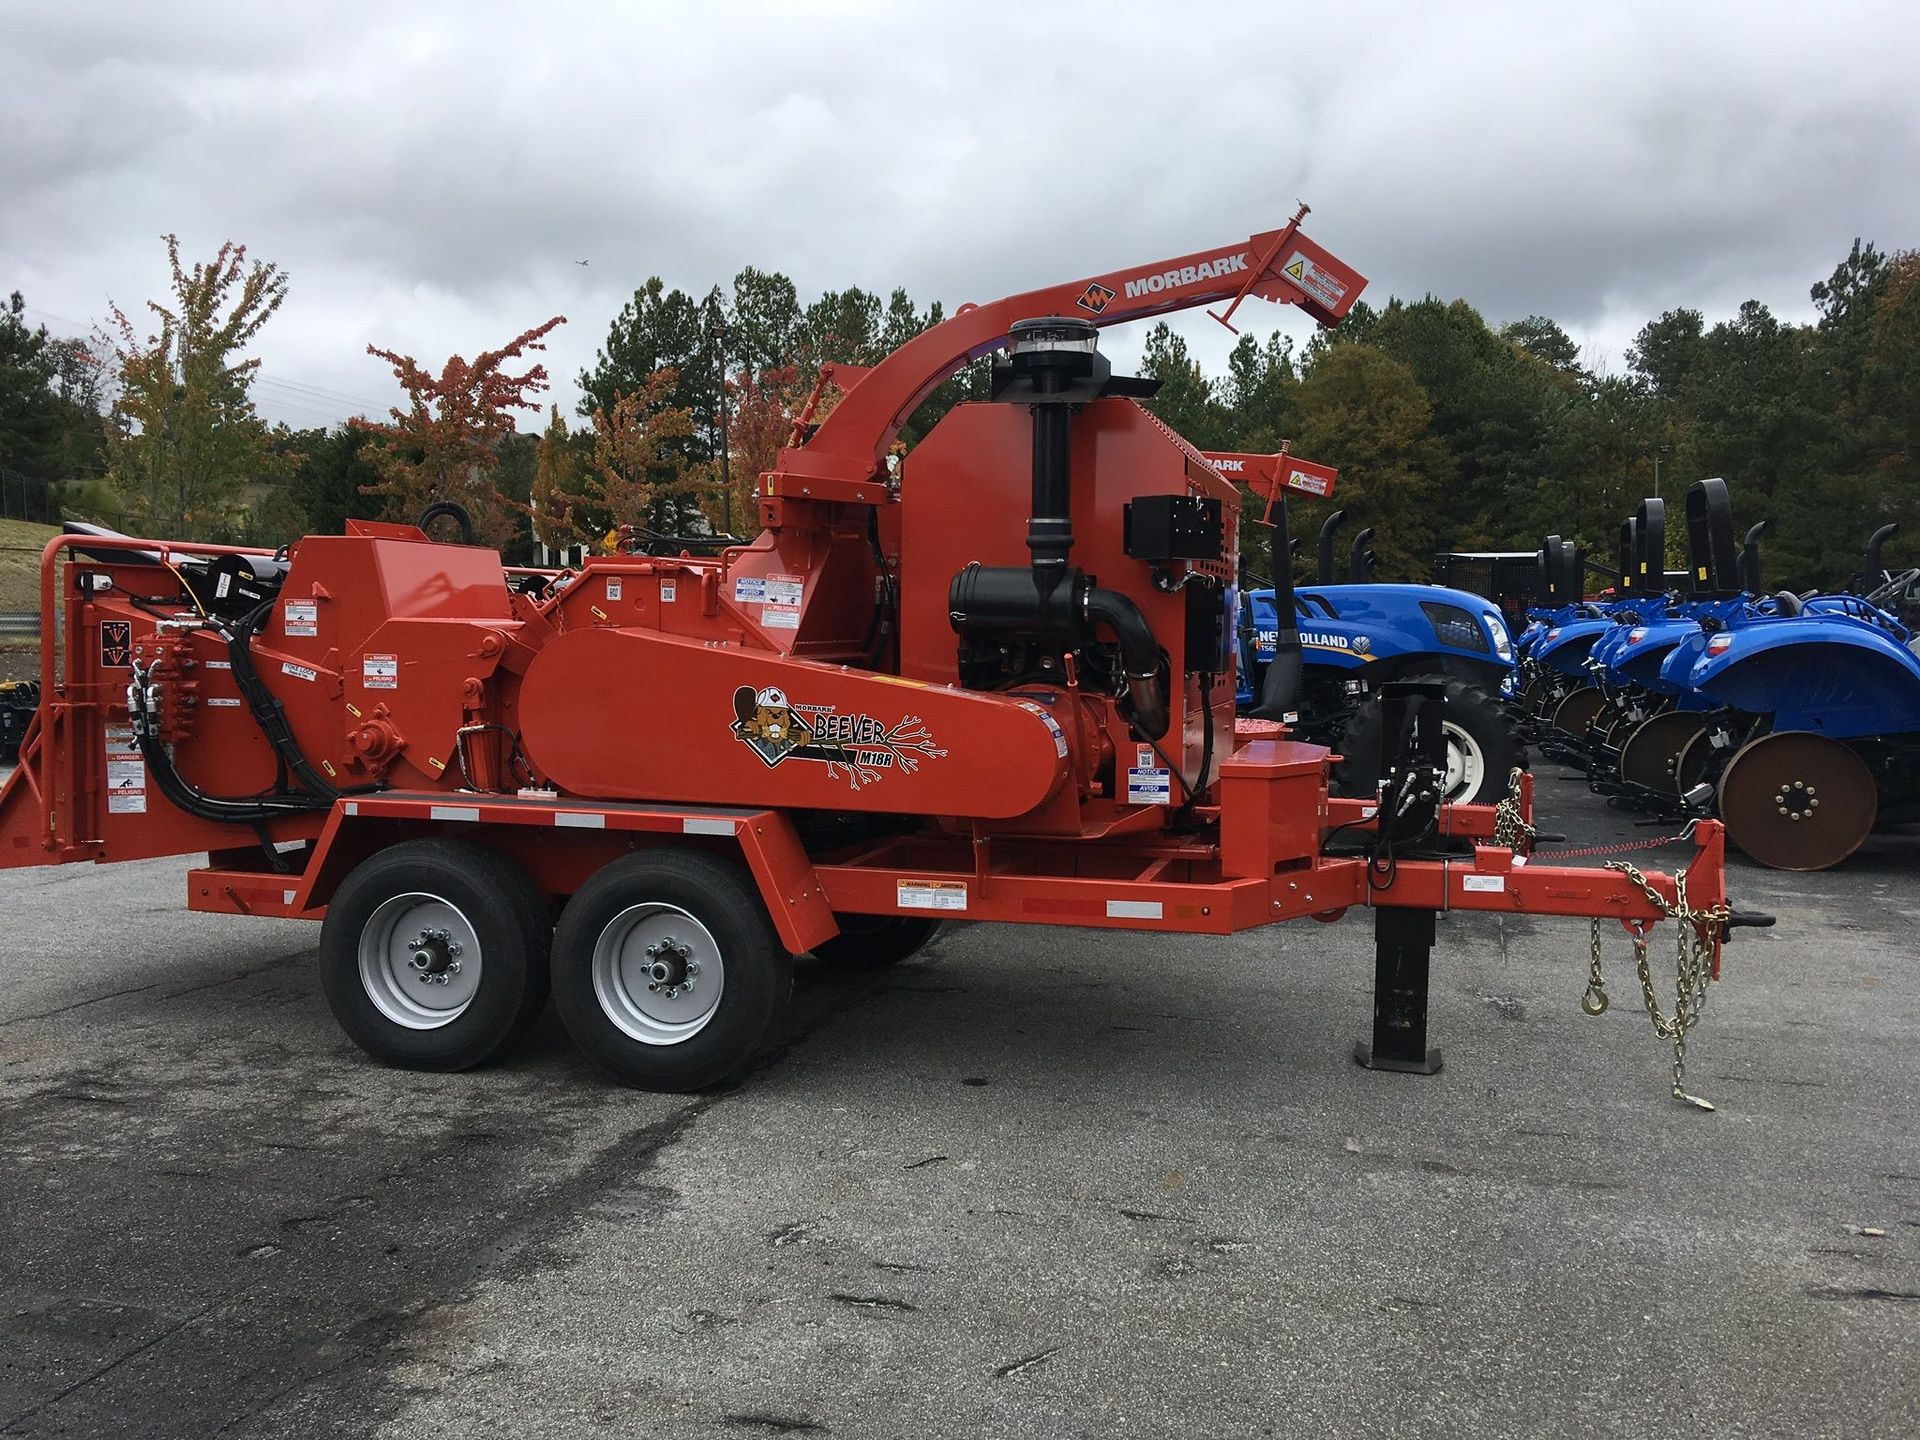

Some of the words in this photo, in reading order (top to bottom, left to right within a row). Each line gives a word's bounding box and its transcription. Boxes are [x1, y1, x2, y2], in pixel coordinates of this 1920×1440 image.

[1124, 253, 1248, 298] MORBARK
[1299, 632, 1348, 648] OLLAND
[794, 704, 832, 713] MORBARK
[813, 712, 887, 745] BEEVER
[859, 750, 894, 767] M18R
